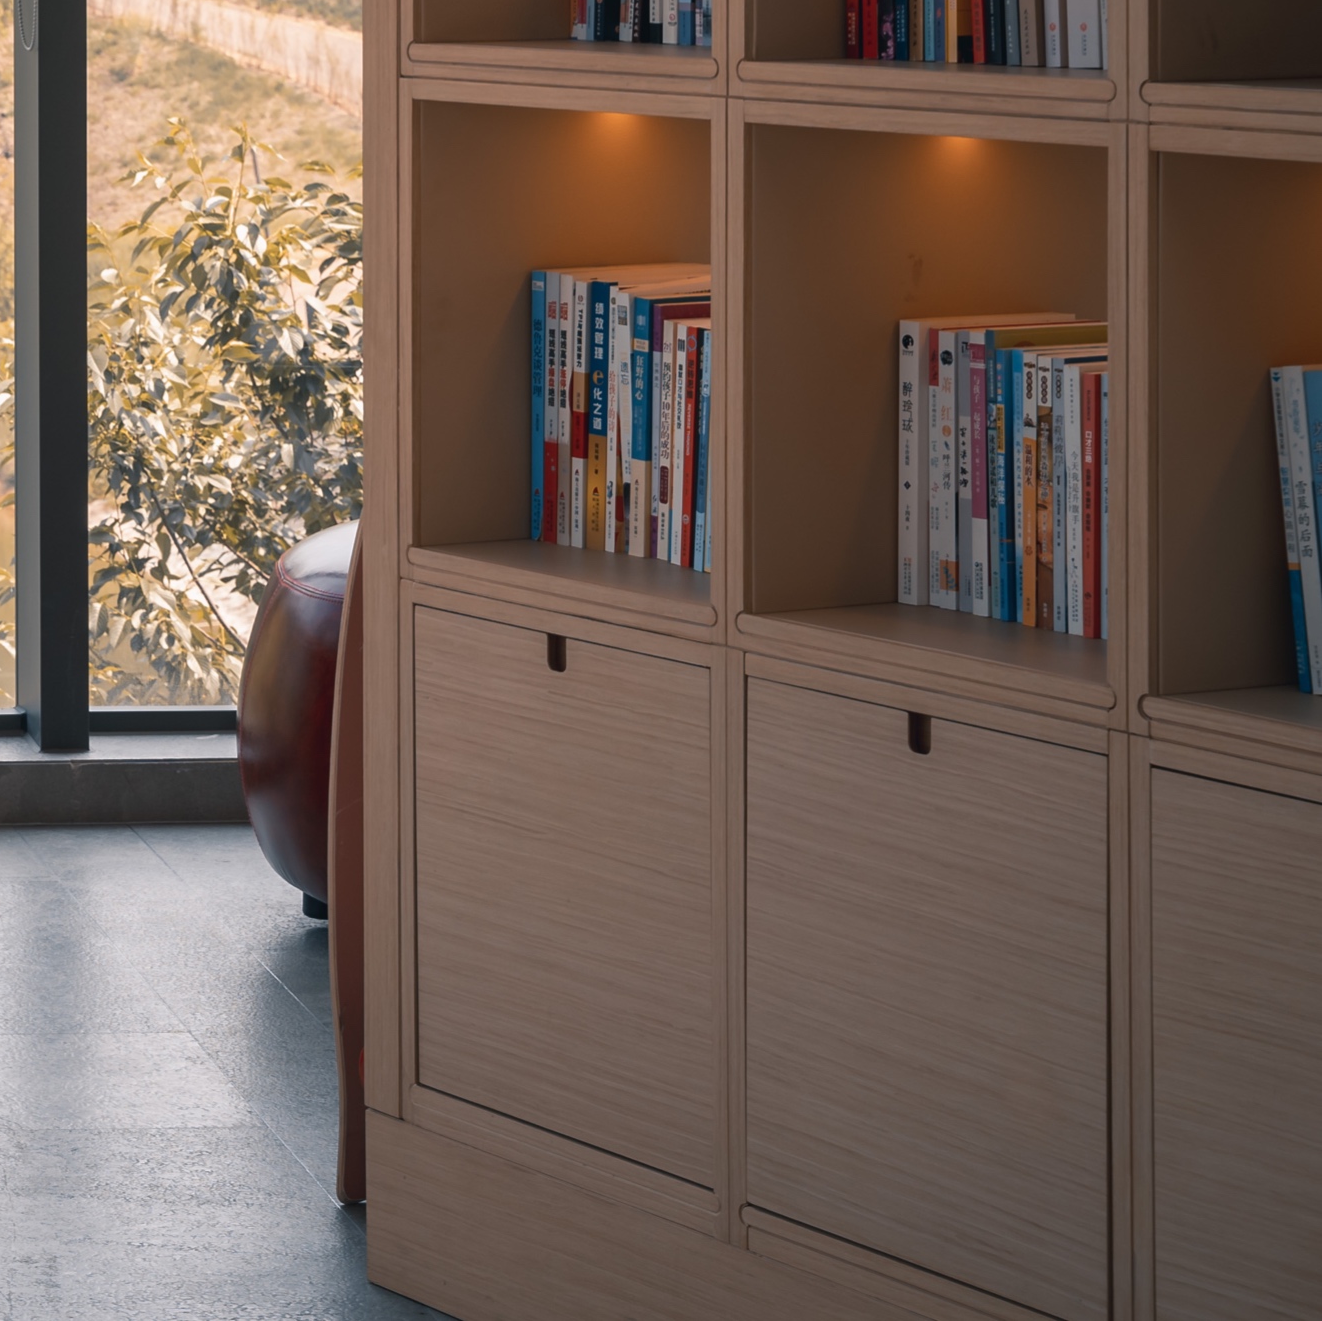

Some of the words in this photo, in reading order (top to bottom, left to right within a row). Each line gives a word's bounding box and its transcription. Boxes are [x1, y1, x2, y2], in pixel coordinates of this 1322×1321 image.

[634, 355, 644, 401] 狂野的心
[1071, 450, 1081, 525] 今天我是升旗手
